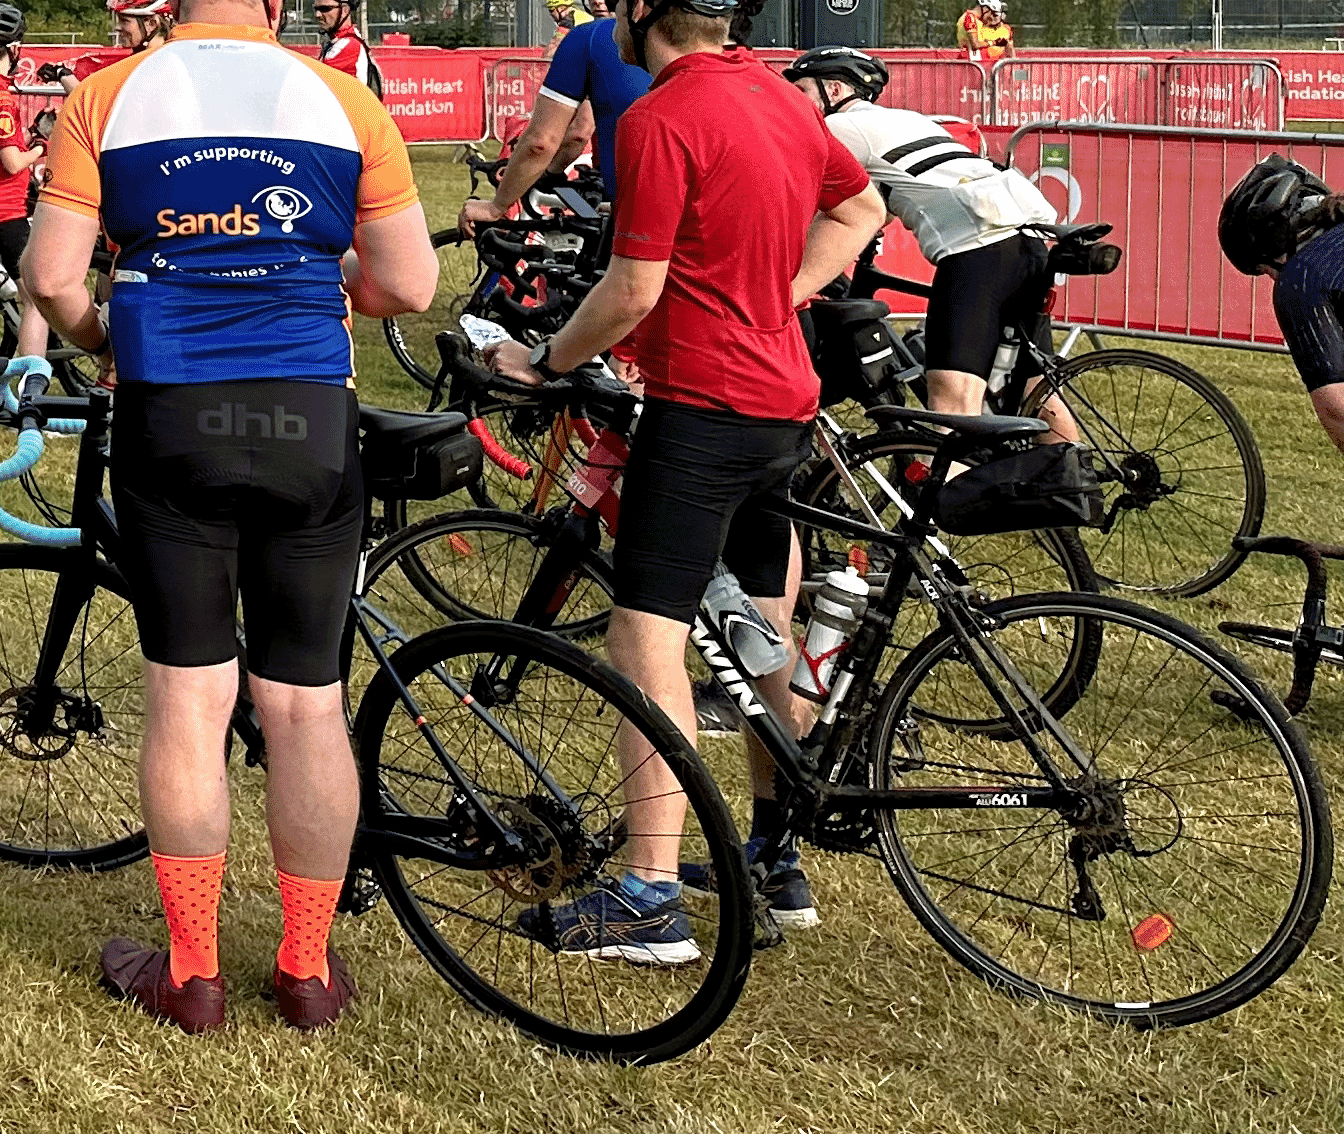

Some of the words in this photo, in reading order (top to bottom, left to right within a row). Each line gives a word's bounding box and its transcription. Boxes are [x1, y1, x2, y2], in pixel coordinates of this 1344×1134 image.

[383, 77, 418, 95] itish
[422, 77, 464, 95] Heart
[386, 100, 454, 116] undation
[159, 155, 192, 176] I'm
[193, 146, 296, 175] supporting
[156, 203, 261, 238] Sands
[151, 252, 168, 268] to
[197, 401, 308, 441] dhb
[992, 793, 1028, 806] 6061
